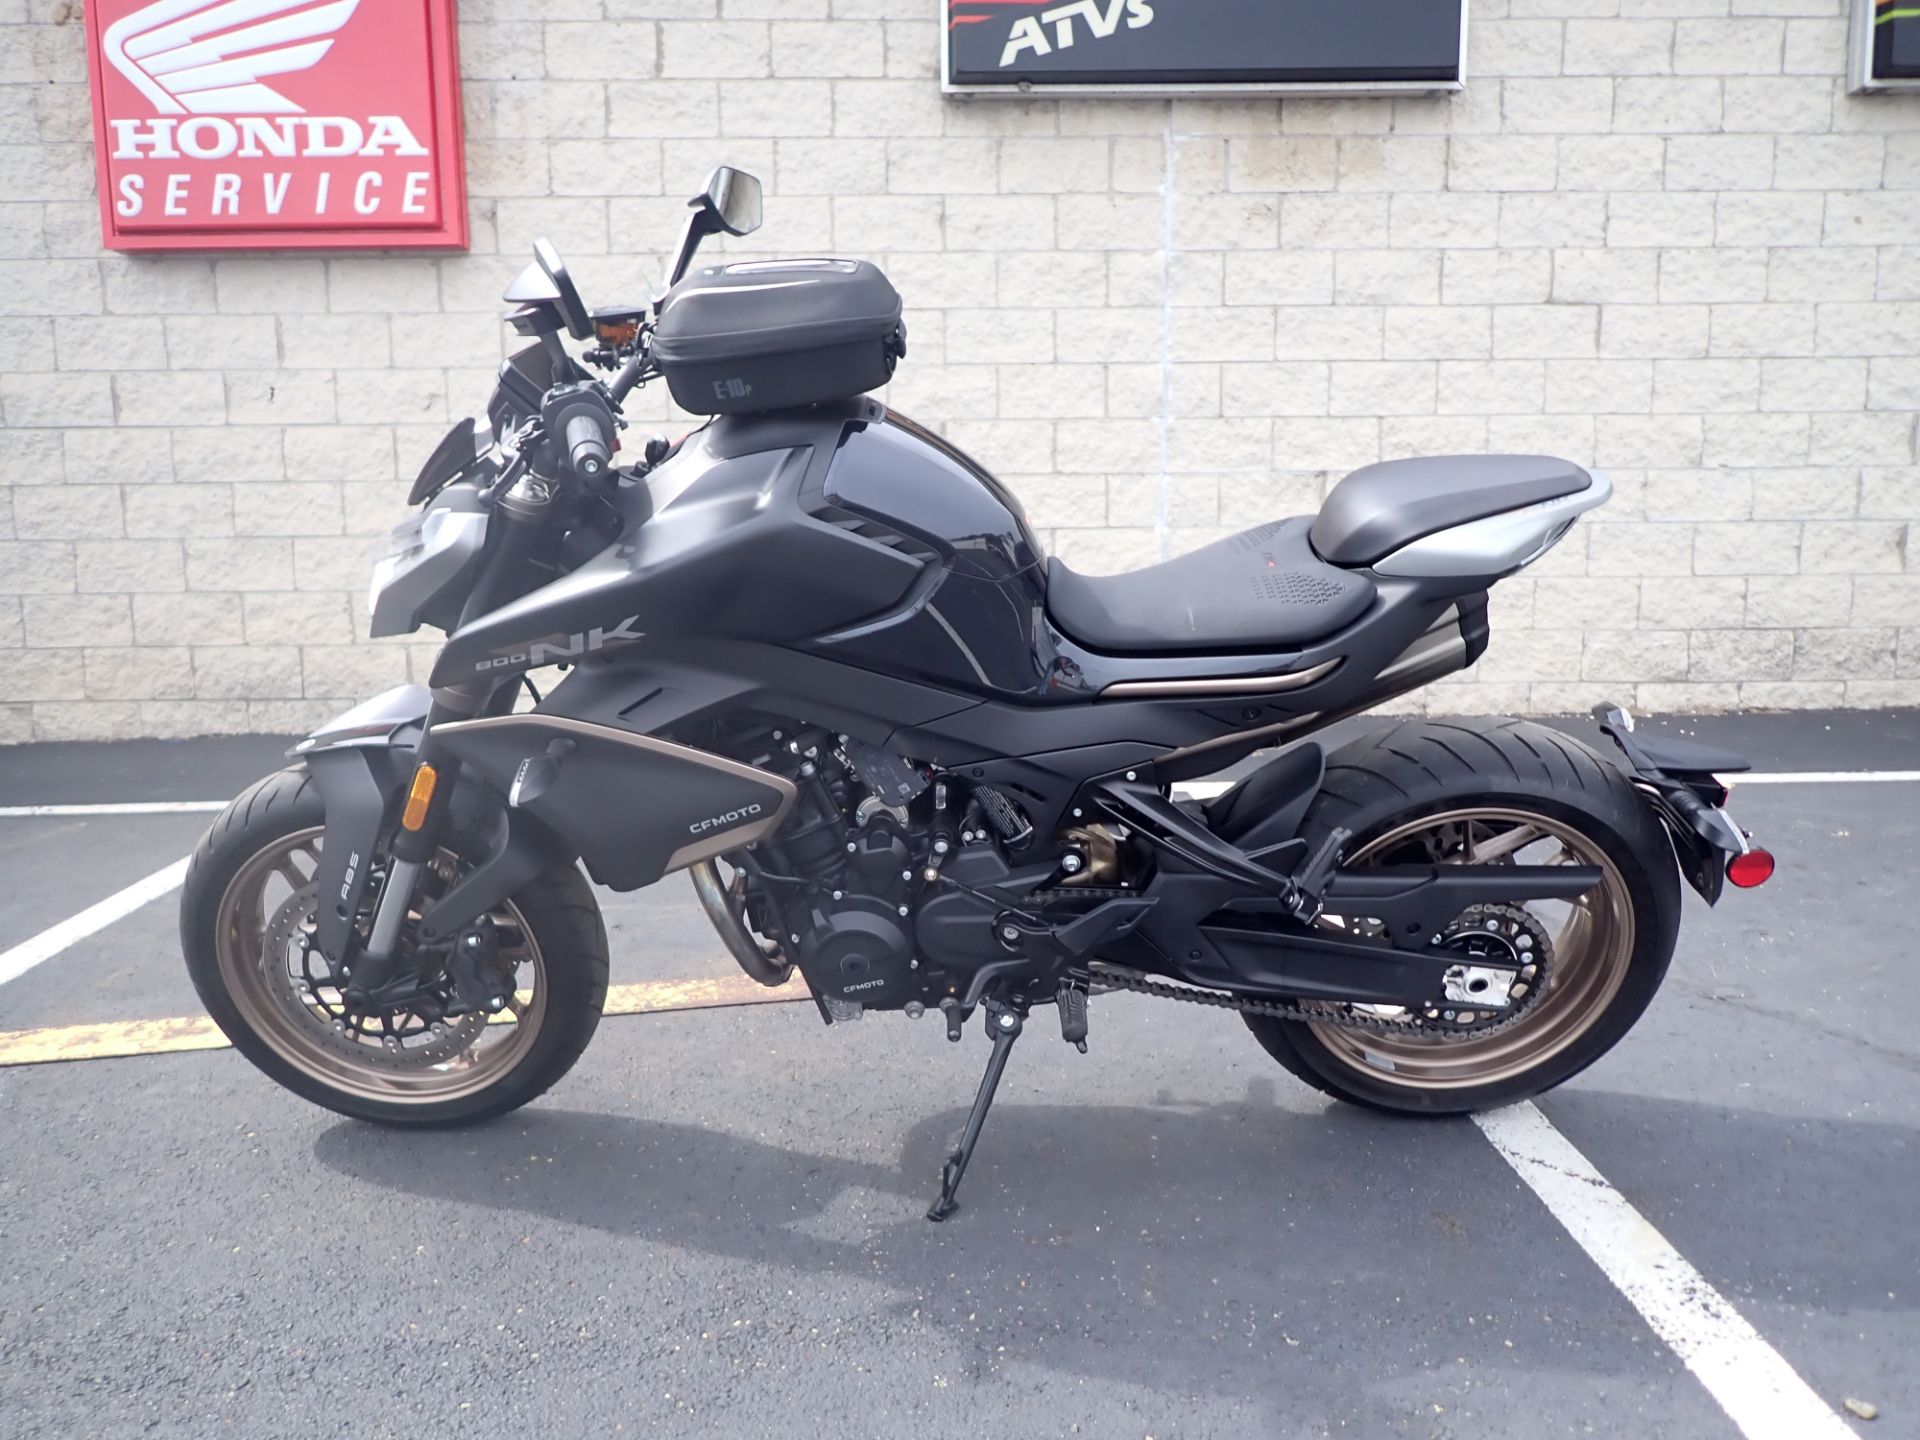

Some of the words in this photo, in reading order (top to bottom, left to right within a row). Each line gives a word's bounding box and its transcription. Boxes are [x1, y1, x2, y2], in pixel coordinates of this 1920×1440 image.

[110, 116, 430, 159] HONDA
[117, 171, 430, 217] SERVICE
[689, 803, 761, 834] CFMOTO
[341, 850, 359, 900] ABS
[843, 979, 884, 993] CFMOTO
